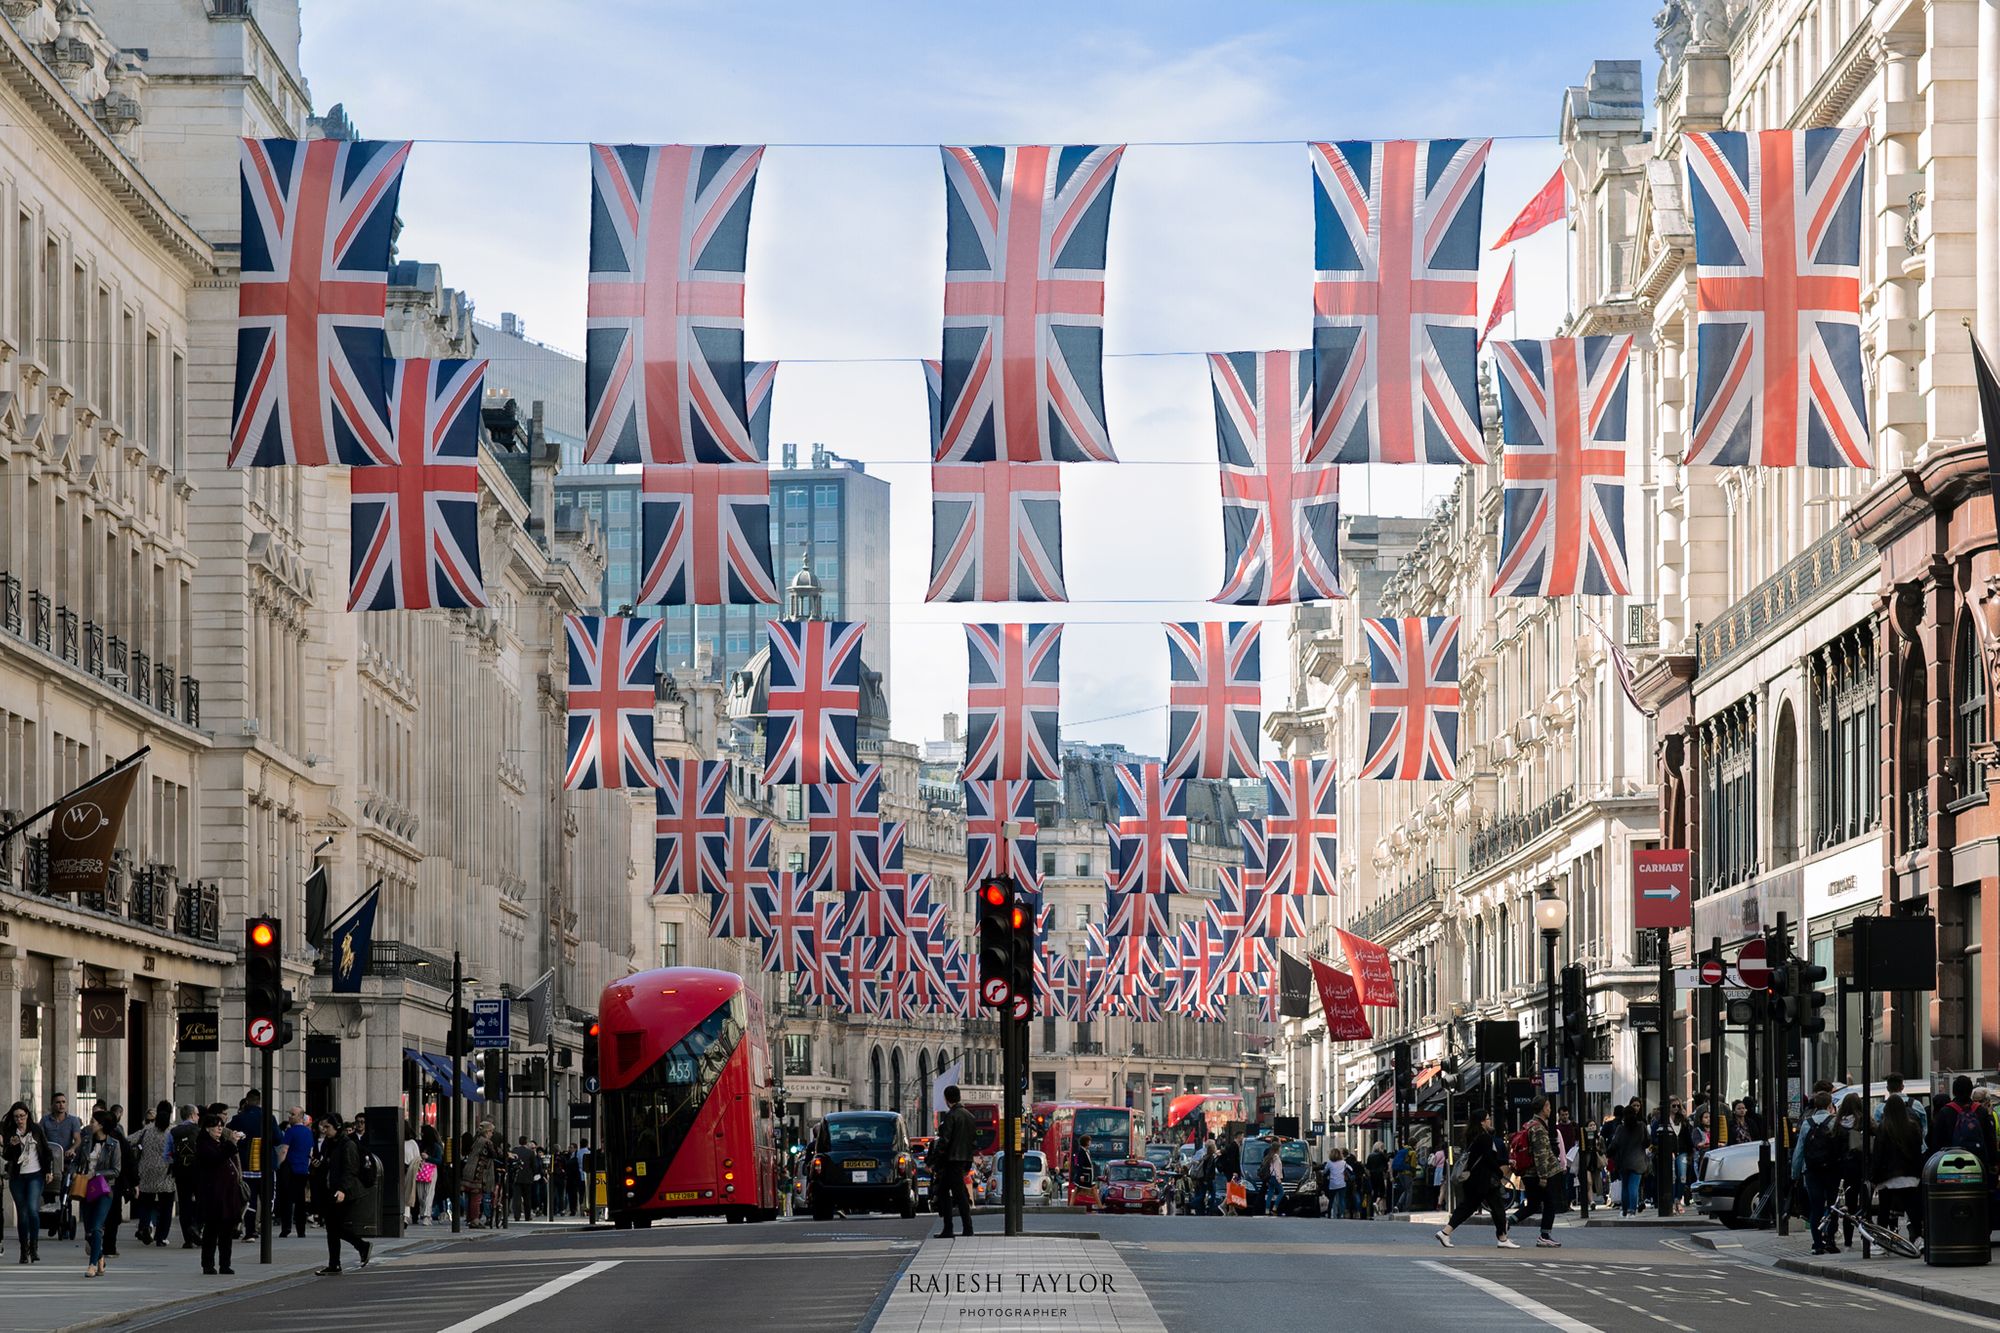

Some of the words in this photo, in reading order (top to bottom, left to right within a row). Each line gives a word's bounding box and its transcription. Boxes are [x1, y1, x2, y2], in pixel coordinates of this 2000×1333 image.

[1638, 863, 1684, 873] CARNABY
[1354, 949, 1385, 961] Hamleys
[1361, 967, 1391, 980] Hamleys
[1325, 984, 1354, 997] Hamleys
[1366, 985, 1396, 1001] Hamleys
[1329, 1003, 1359, 1017] Hamleys
[181, 1023, 217, 1040] J.Crew
[1336, 1023, 1365, 1037] Hamleys
[669, 1062, 690, 1079] 453
[1112, 1142, 1123, 1150] 23
